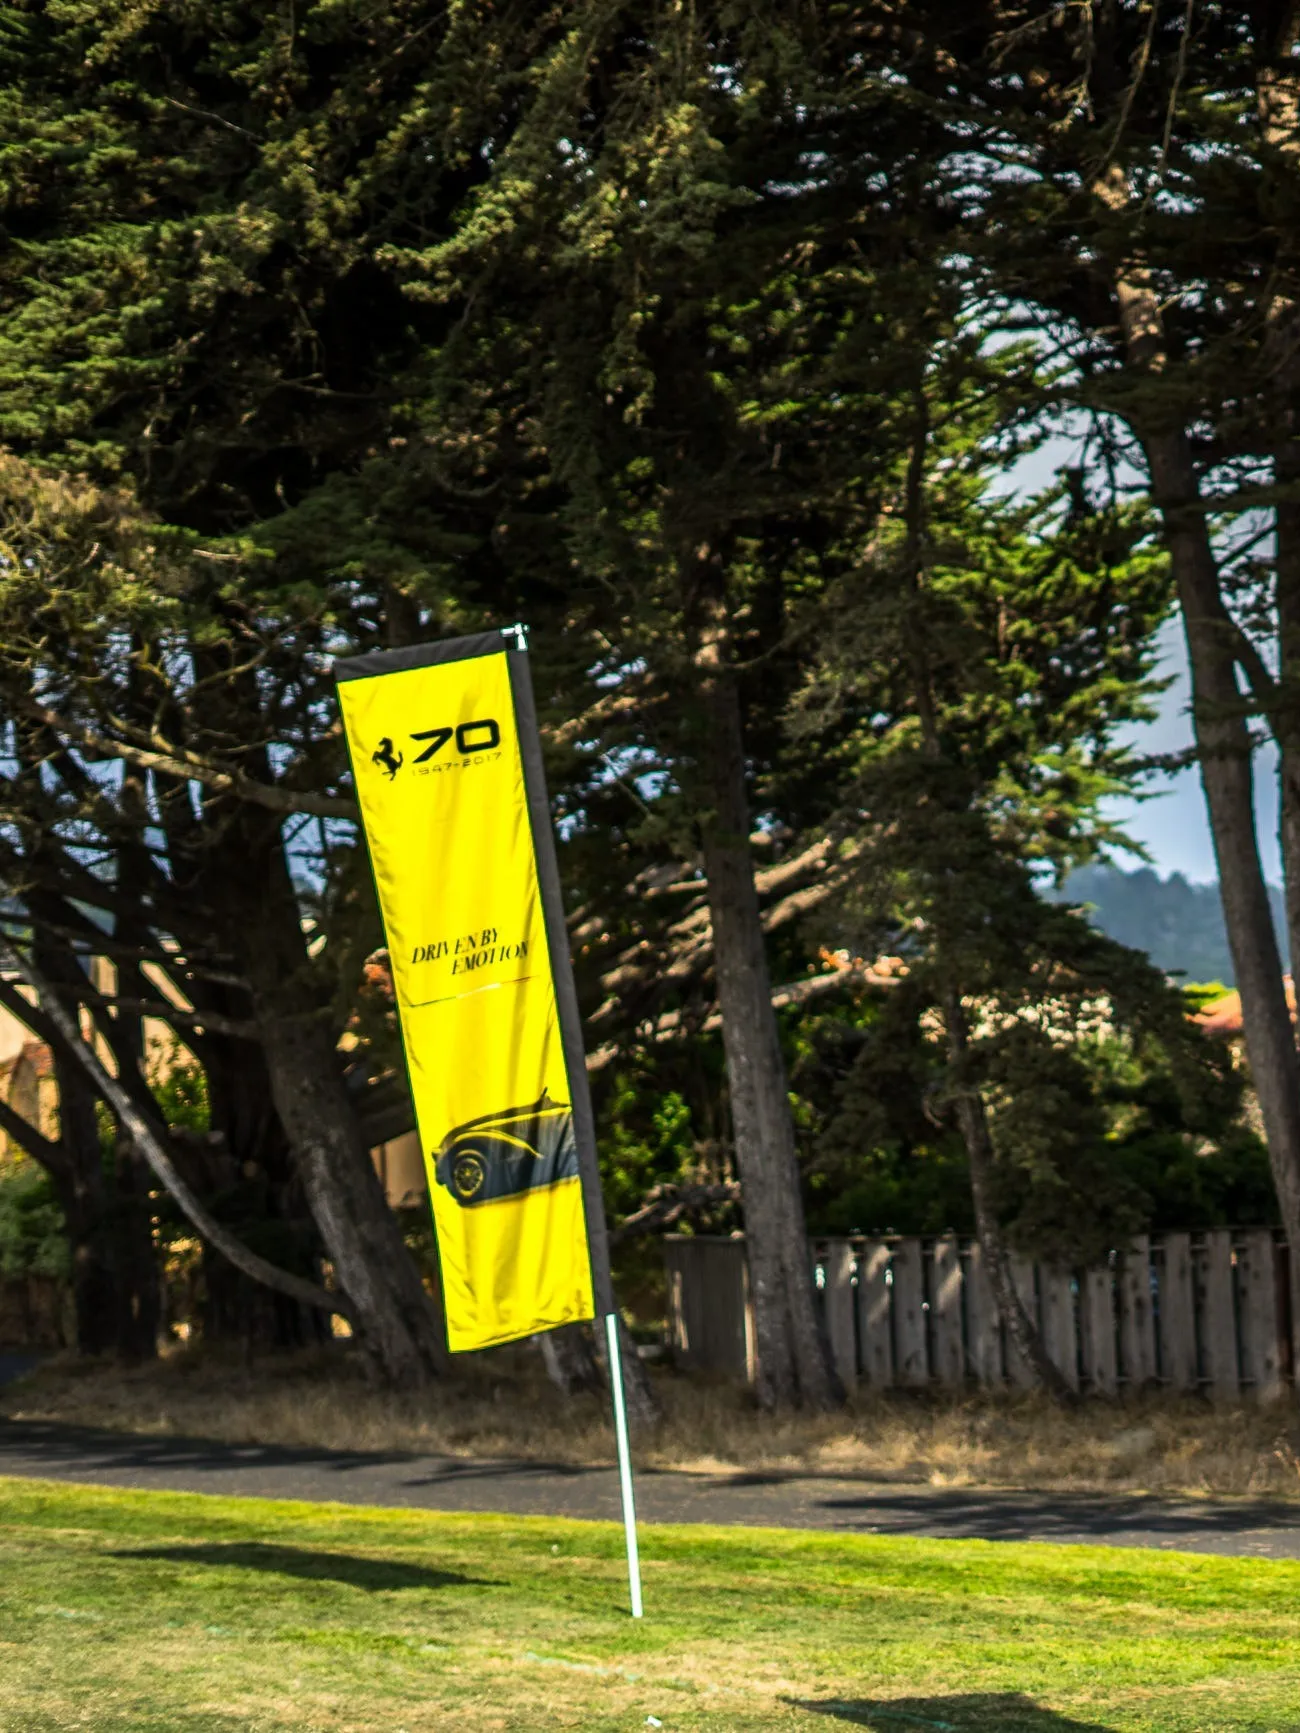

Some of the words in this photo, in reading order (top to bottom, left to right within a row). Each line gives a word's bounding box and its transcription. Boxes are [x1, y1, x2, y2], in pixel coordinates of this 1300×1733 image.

[408, 718, 501, 764] 70
[411, 931, 479, 964] DRIVEN
[452, 940, 529, 975] EMOTION
